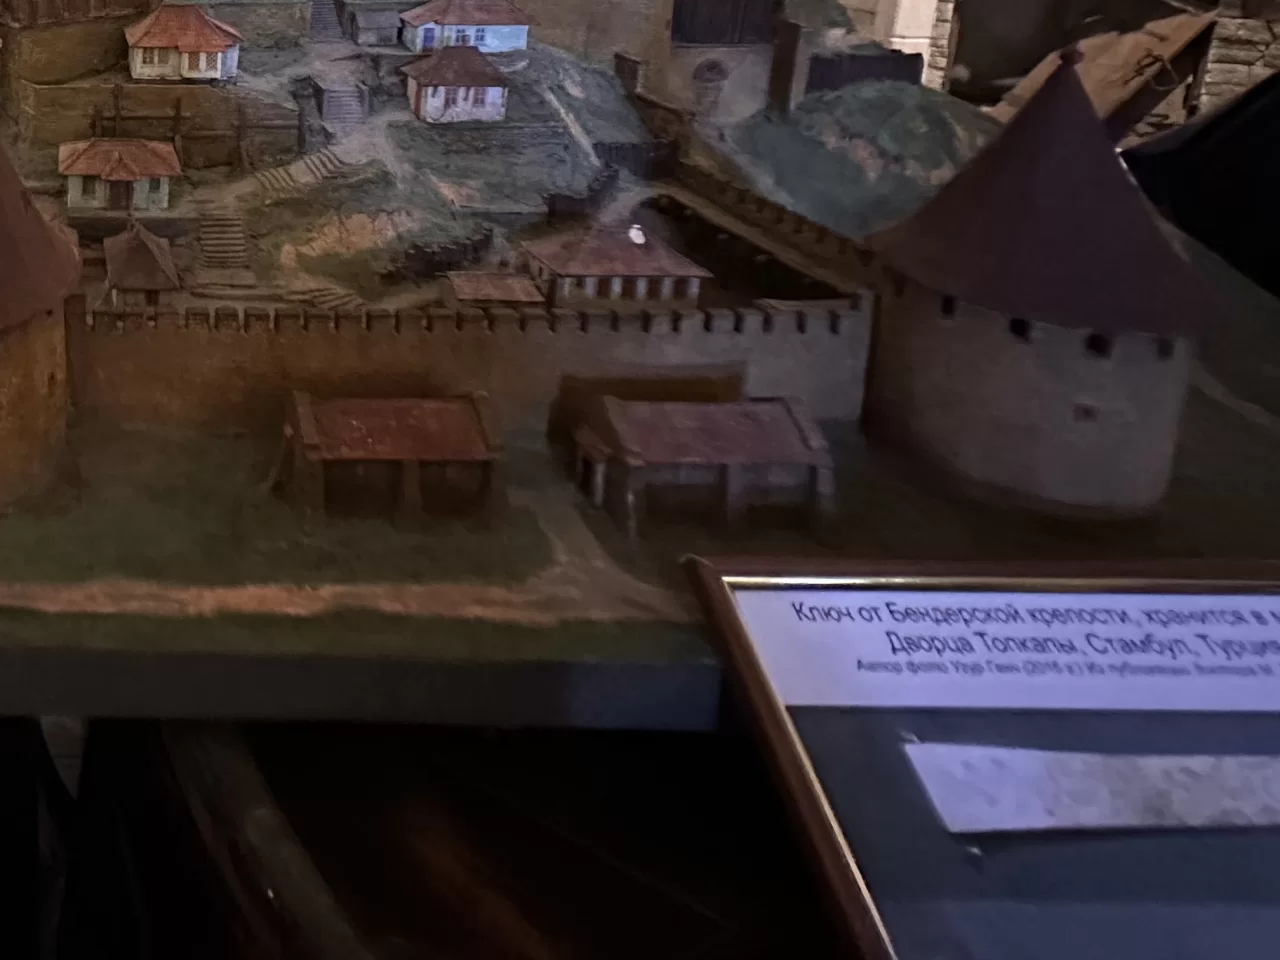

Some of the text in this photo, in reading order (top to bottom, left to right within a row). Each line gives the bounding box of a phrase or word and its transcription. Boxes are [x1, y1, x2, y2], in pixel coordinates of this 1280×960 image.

[792, 600, 855, 623] Ключ
[858, 605, 883, 624] от
[885, 601, 1025, 628] Бендерской
[1025, 607, 1143, 629] крепости,
[885, 631, 975, 657] Дворца
[972, 631, 1089, 656] Топкапы,
[1084, 632, 1201, 660] Стамбул,
